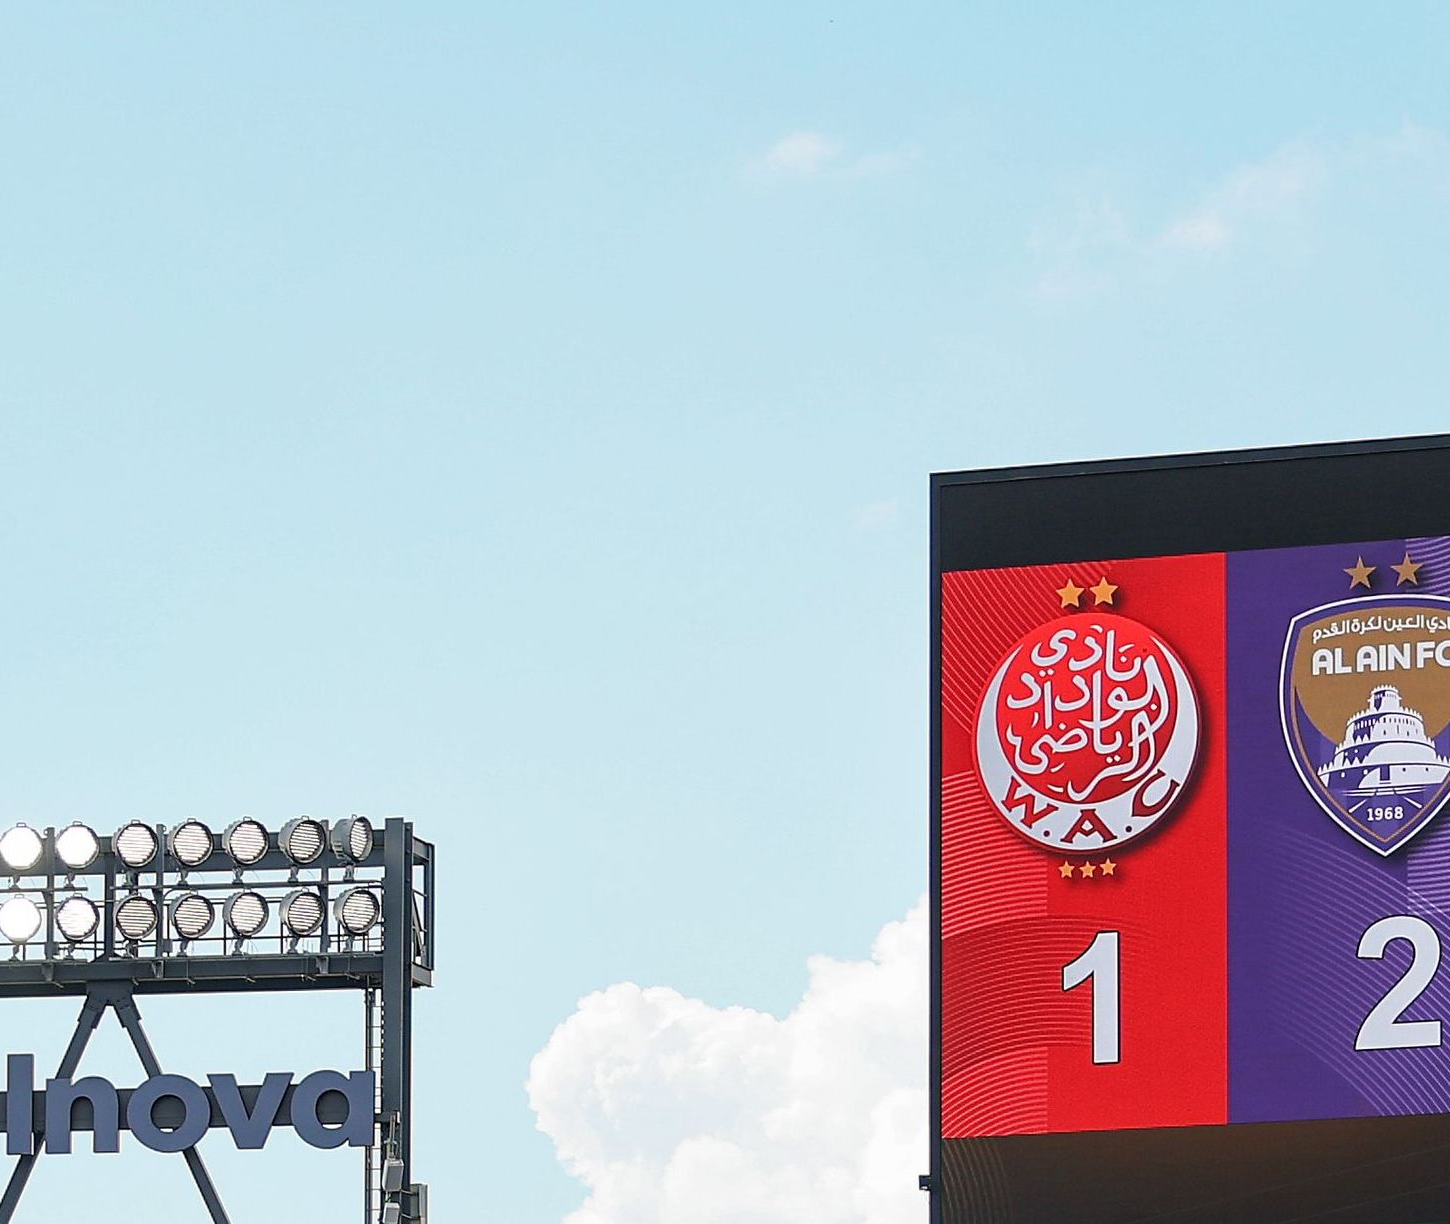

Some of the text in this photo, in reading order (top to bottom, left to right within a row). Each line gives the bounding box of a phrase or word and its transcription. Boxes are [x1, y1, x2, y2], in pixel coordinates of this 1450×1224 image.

[1312, 620, 1350, 644] القدم
[1351, 616, 1382, 635] لكرة
[1383, 615, 1424, 632] العين
[1312, 648, 1352, 676] AL
[1356, 643, 1411, 673] AIN
[1367, 806, 1404, 821] 1968
[1354, 914, 1442, 1051] 2
[1062, 930, 1121, 1065] 1
[7, 1053, 375, 1156] Inova
